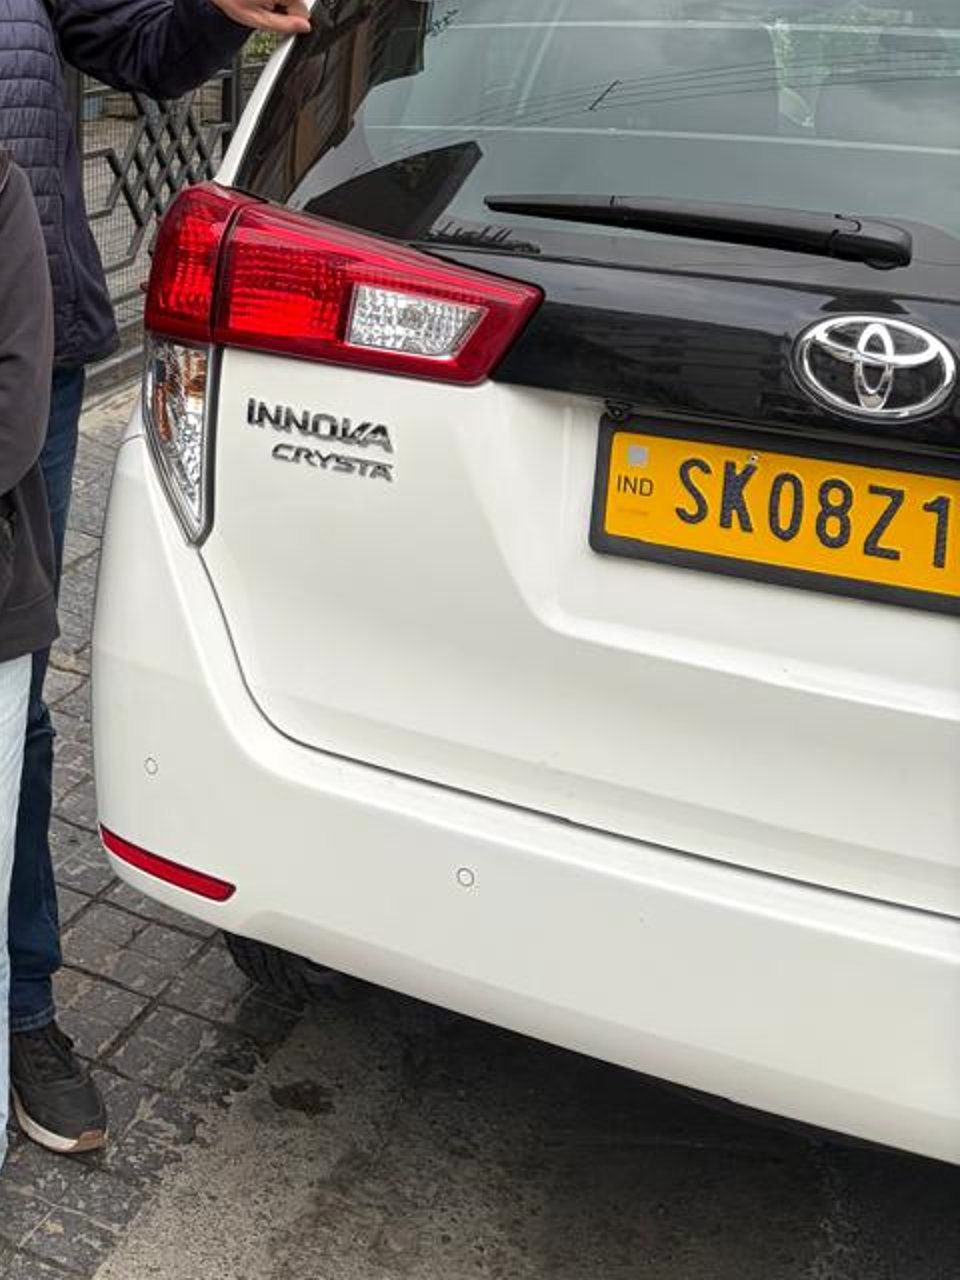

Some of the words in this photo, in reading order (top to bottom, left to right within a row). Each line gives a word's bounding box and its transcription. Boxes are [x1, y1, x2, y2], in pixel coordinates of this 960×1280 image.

[247, 397, 394, 453] INNOVA
[271, 443, 394, 482] CRYSTA
[616, 474, 654, 497] IND
